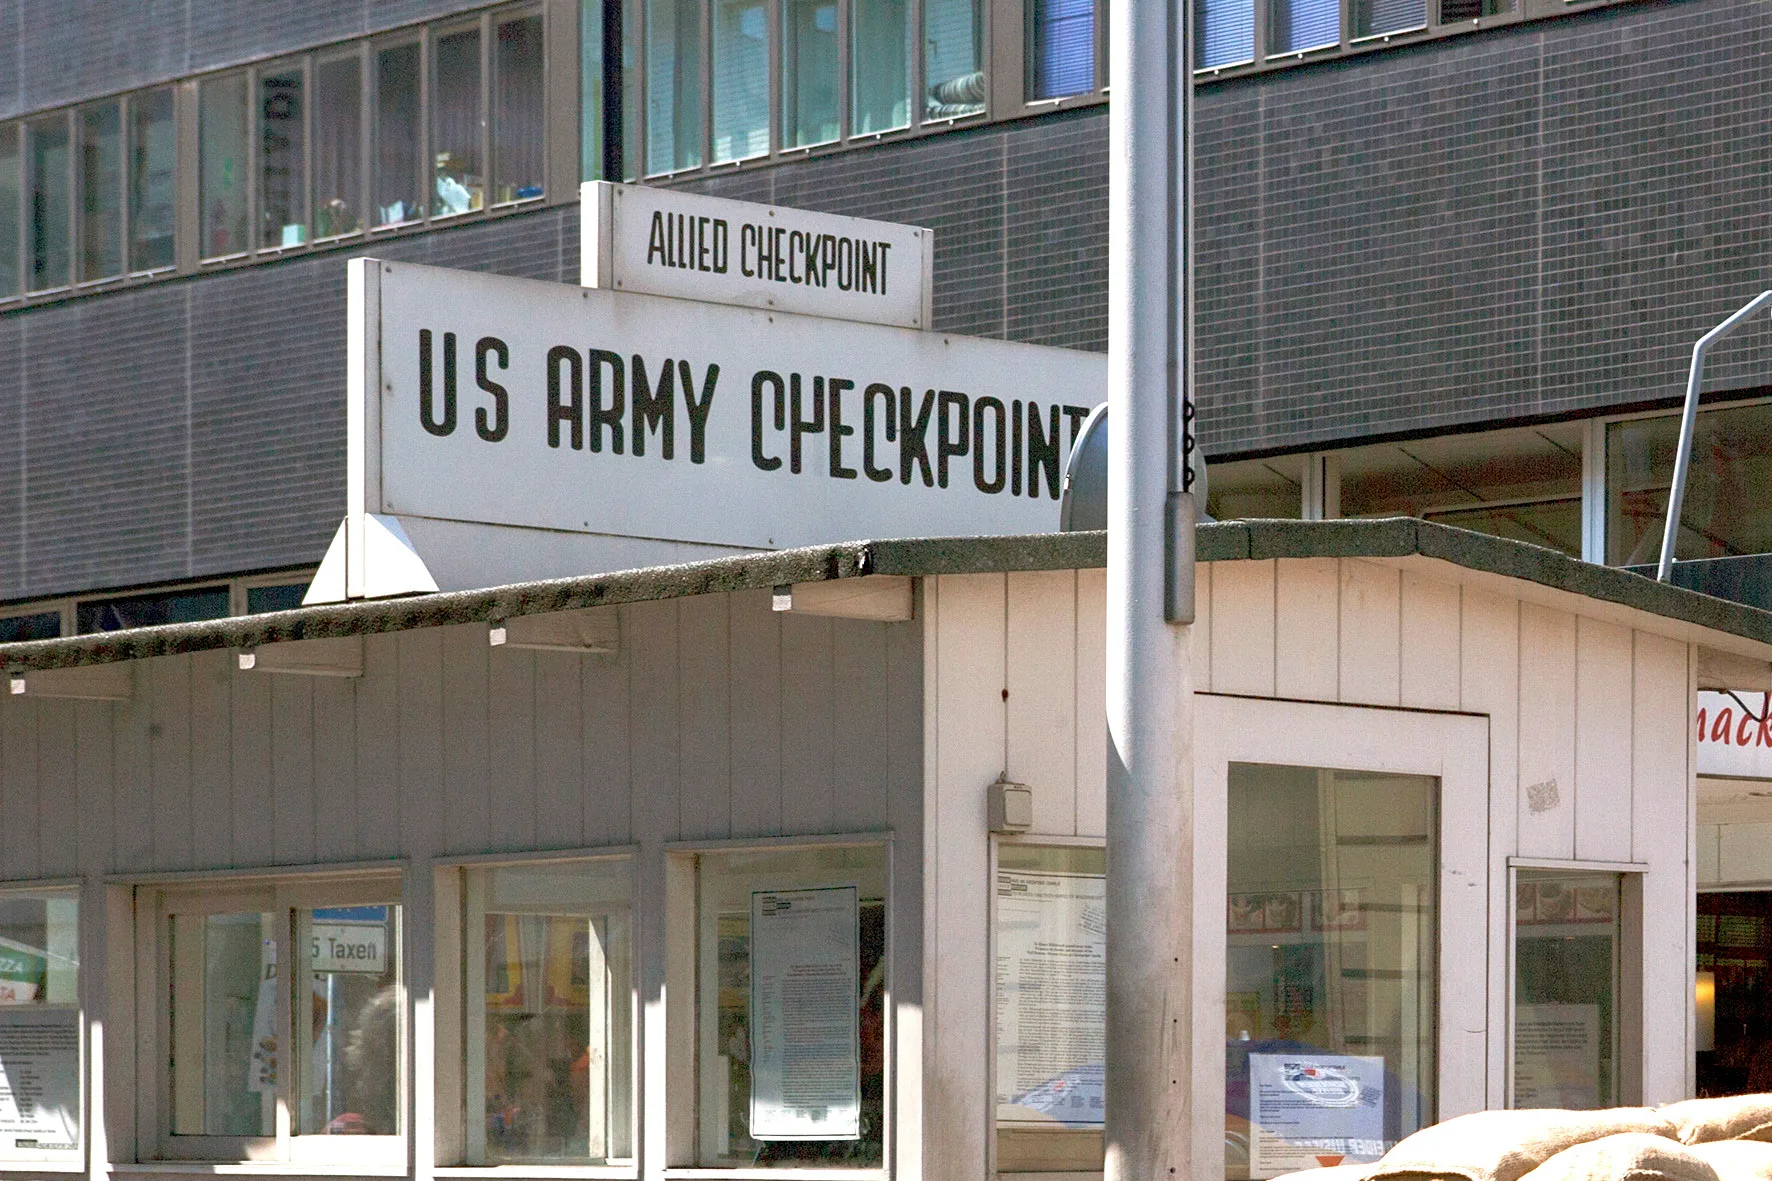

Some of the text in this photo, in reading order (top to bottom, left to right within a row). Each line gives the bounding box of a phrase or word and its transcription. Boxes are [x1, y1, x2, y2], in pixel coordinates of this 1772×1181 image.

[647, 210, 892, 296] ALLIED CHECKPOINT
[419, 328, 509, 443] US
[547, 345, 720, 465] ARMY
[328, 937, 377, 961] Taxen
